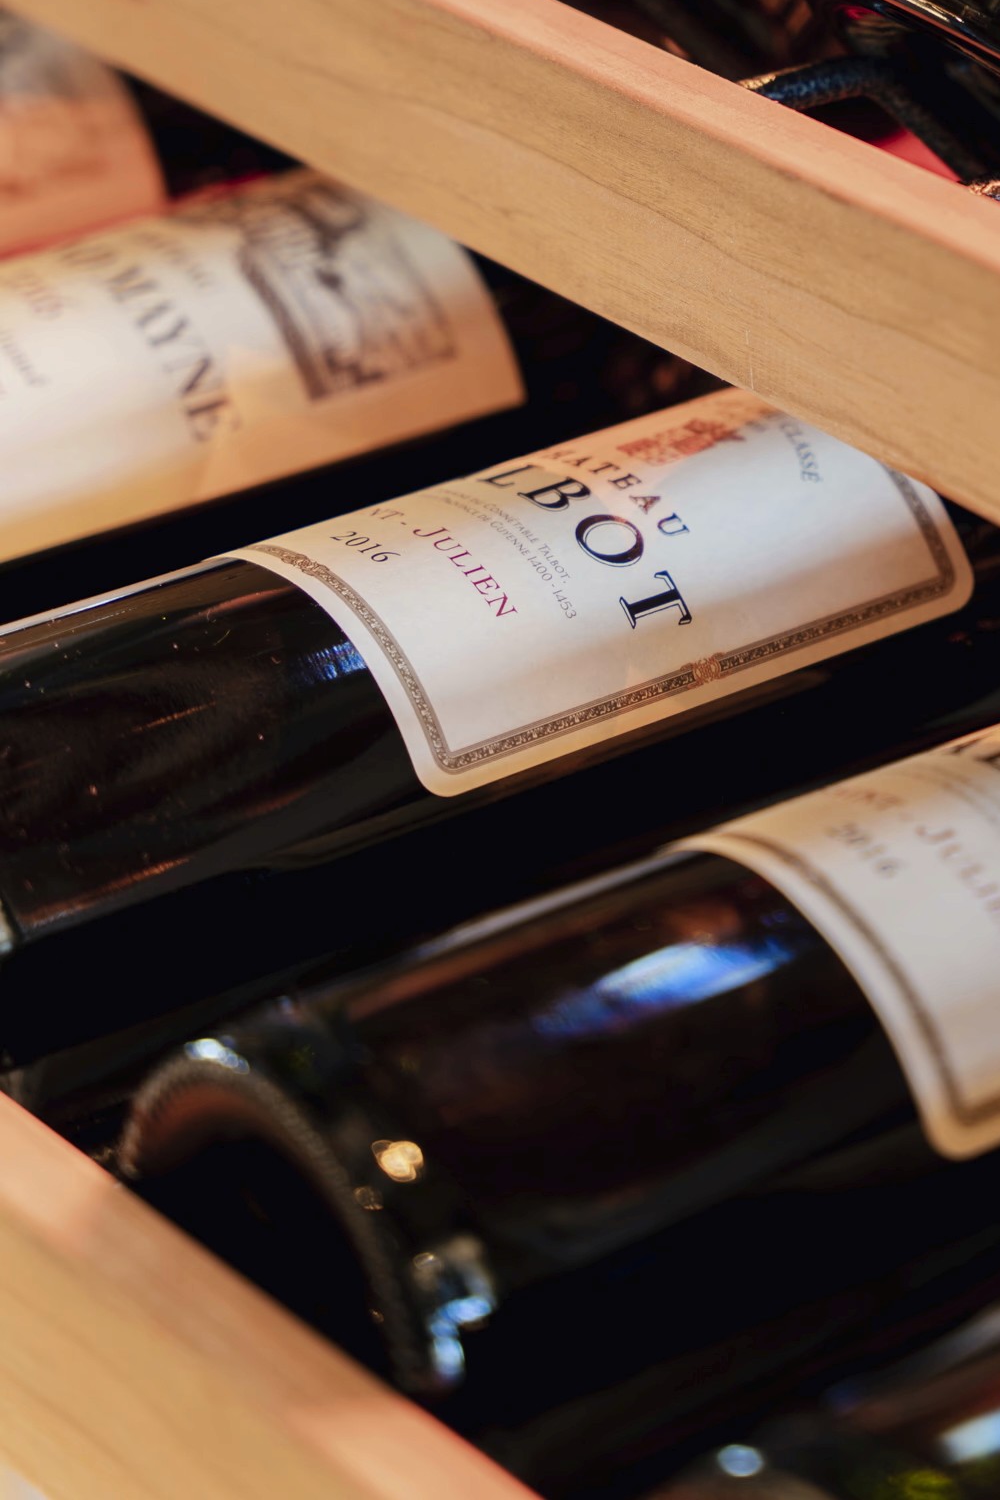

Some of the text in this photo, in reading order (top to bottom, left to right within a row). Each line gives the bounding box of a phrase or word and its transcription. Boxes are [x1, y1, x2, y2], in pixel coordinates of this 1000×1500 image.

[330, 530, 401, 563] 2016
[413, 526, 518, 618] JULIEN
[476, 464, 692, 630] LBOT
[526, 556, 553, 582] 1400
[552, 589, 577, 620] 1453
